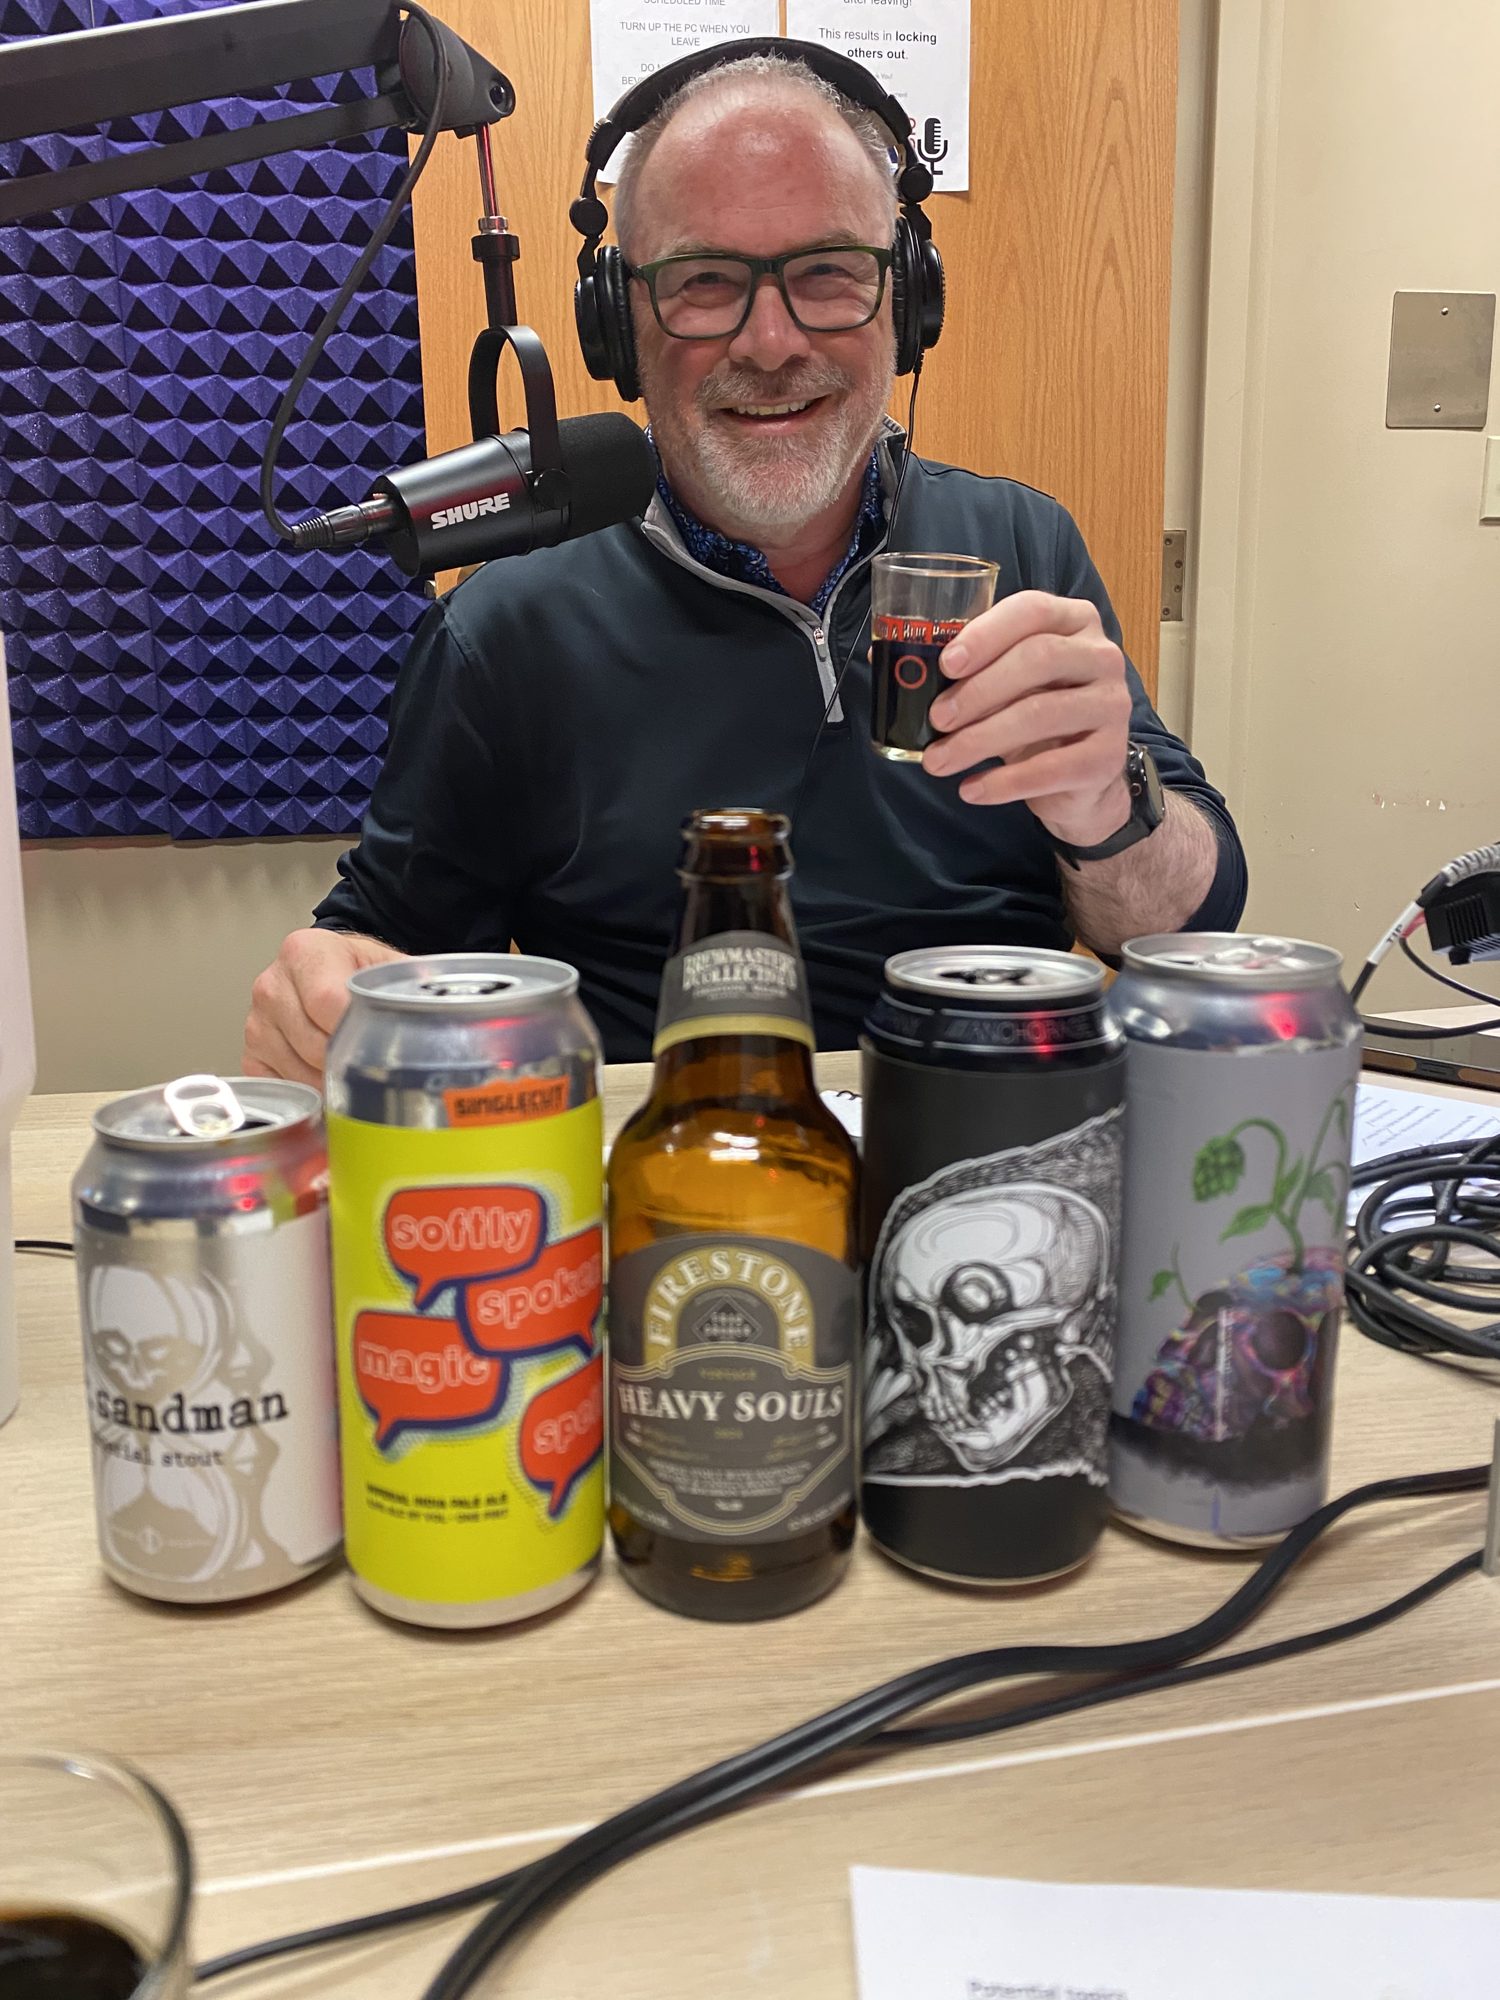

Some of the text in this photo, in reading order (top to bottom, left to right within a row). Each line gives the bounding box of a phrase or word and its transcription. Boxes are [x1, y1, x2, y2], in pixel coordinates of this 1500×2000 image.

[620, 22, 750, 34] TURN UP THE PC WHEN YOU
[819, 27, 937, 45] This results in locking
[671, 37, 700, 46] LEAVE
[847, 48, 883, 59] others
[641, 63, 655, 72] DO
[431, 492, 510, 530] SHURE
[391, 1206, 533, 1253] softly
[649, 1250, 808, 1351] FIRESTONE
[359, 1341, 491, 1394] magic
[618, 1383, 844, 1422] HEAVY SOULS
[161, 1450, 225, 1468] stout
